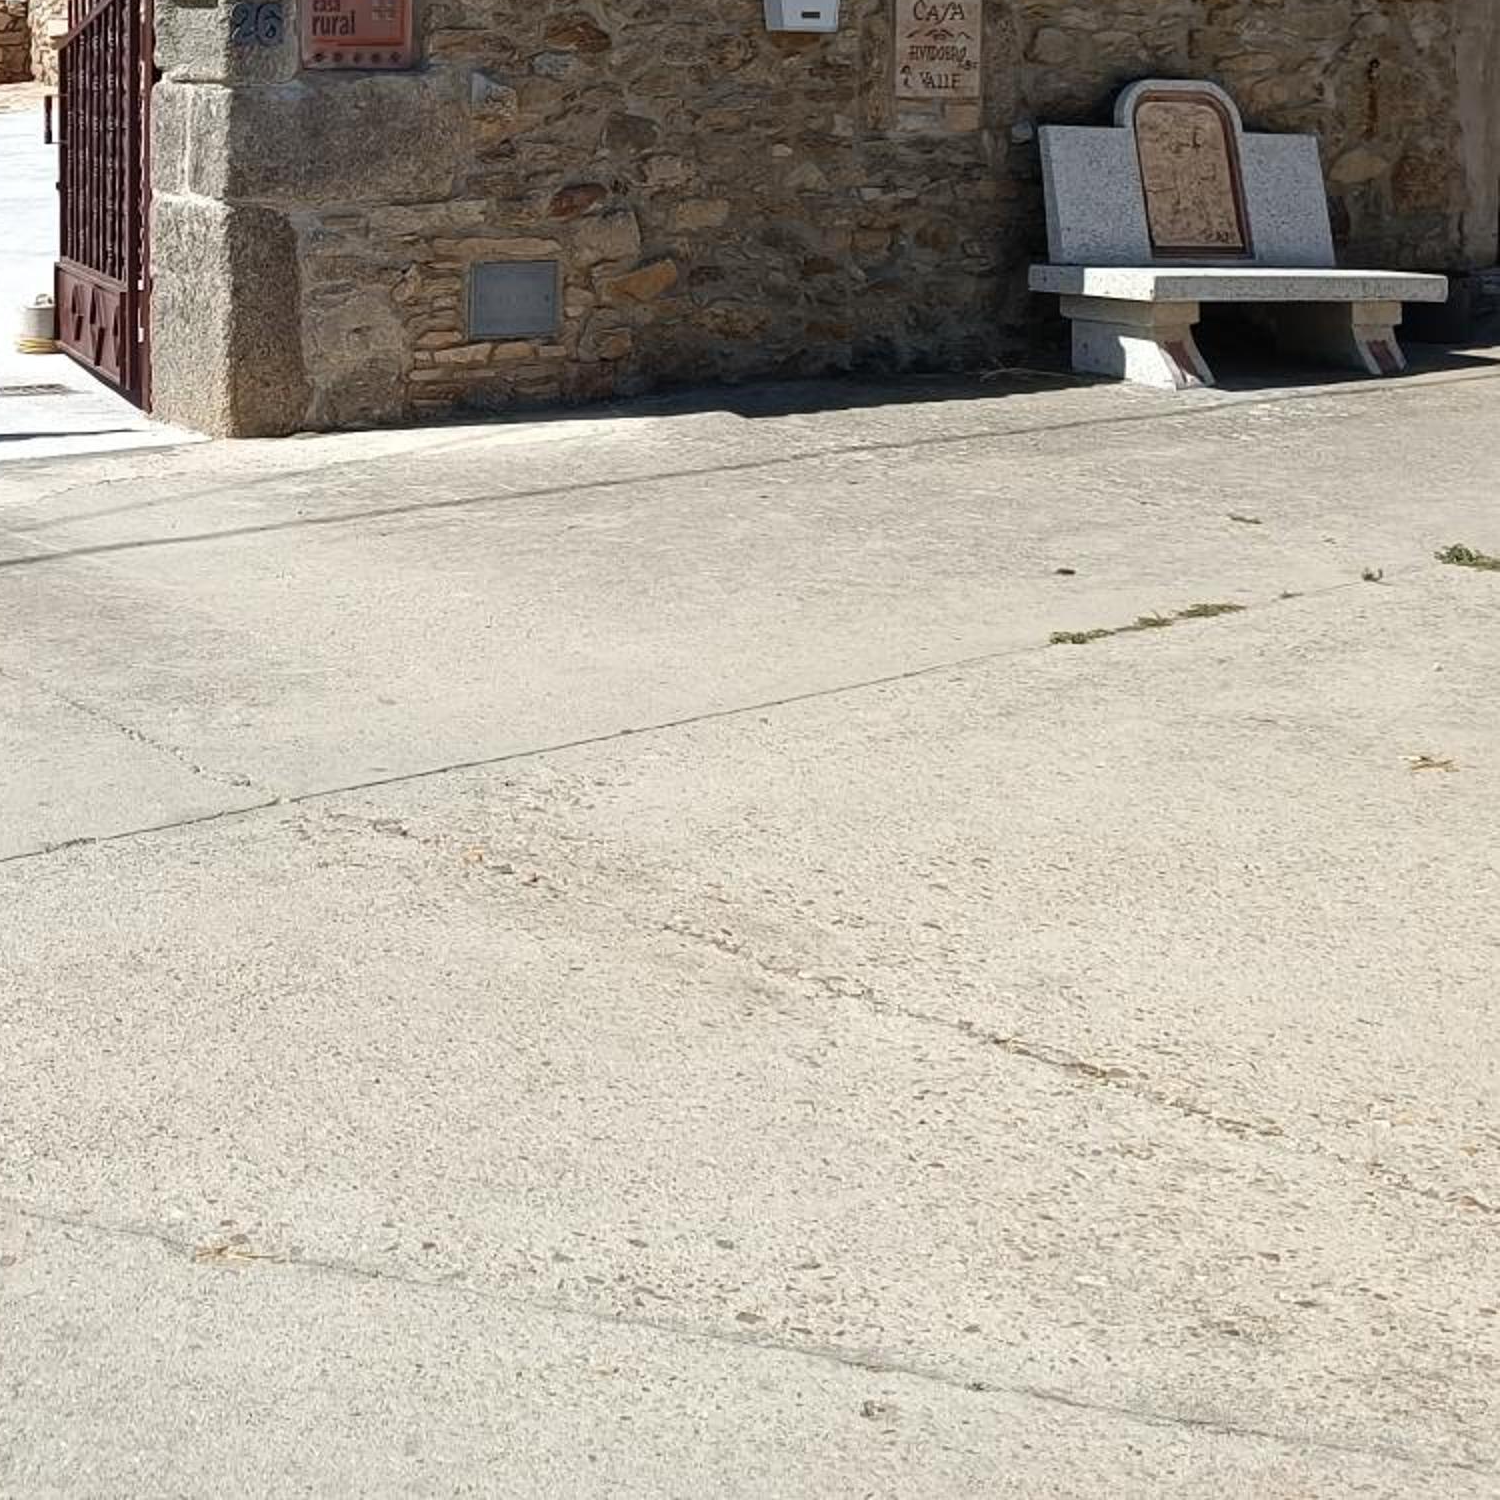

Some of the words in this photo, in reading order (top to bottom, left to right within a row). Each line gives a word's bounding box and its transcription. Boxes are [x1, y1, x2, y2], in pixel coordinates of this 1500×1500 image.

[312, 0, 341, 13] casa
[230, 2, 283, 47] 26
[311, 10, 356, 36] rural
